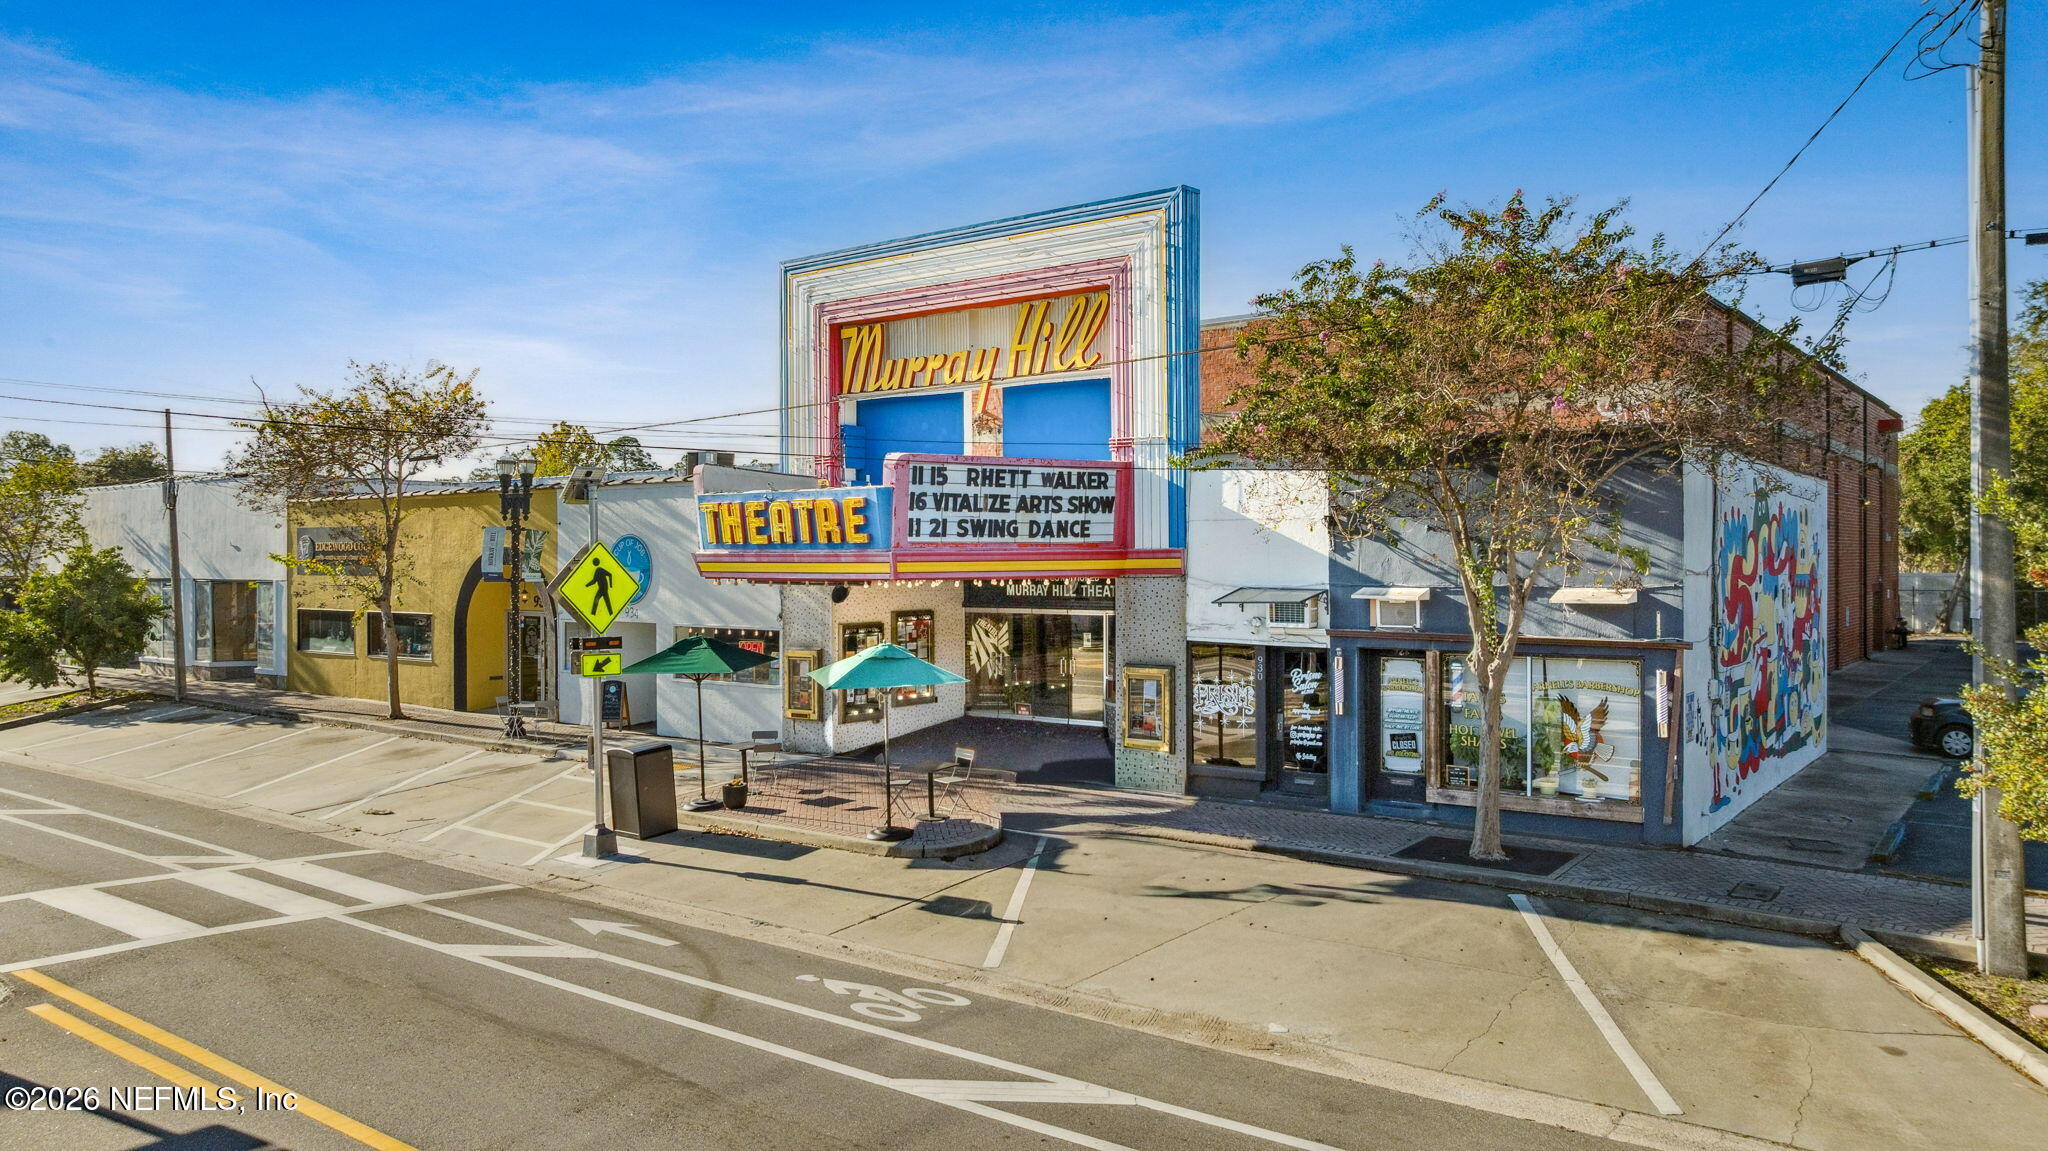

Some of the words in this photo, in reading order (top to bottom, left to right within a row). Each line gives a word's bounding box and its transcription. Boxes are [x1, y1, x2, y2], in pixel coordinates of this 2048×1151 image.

[841, 323, 999, 414] Murray
[1006, 293, 1110, 378] Hill
[930, 466, 948, 485] 15
[966, 468, 1031, 488] RHETT
[1041, 471, 1109, 490] WALKER
[909, 491, 927, 511] 16
[932, 492, 1011, 513] VITALIZE
[1015, 494, 1063, 513] ARTS
[1067, 496, 1115, 514] SHOW
[700, 497, 871, 545] THEATRE
[929, 518, 947, 537] 21
[956, 518, 1019, 538] SWING
[1028, 519, 1092, 539] DANCE
[315, 541, 353, 552] EDGEWOOD
[625, 539, 635, 547] OF
[1006, 585, 1049, 597] MURRAY
[1052, 585, 1077, 597] HILL
[1290, 668, 1323, 682] Prism
[1291, 678, 1320, 693] Salon
[1575, 680, 1641, 698] BARBERSHOP
[1449, 724, 1474, 736] HOT
[1391, 740, 1416, 750] CLOSED
